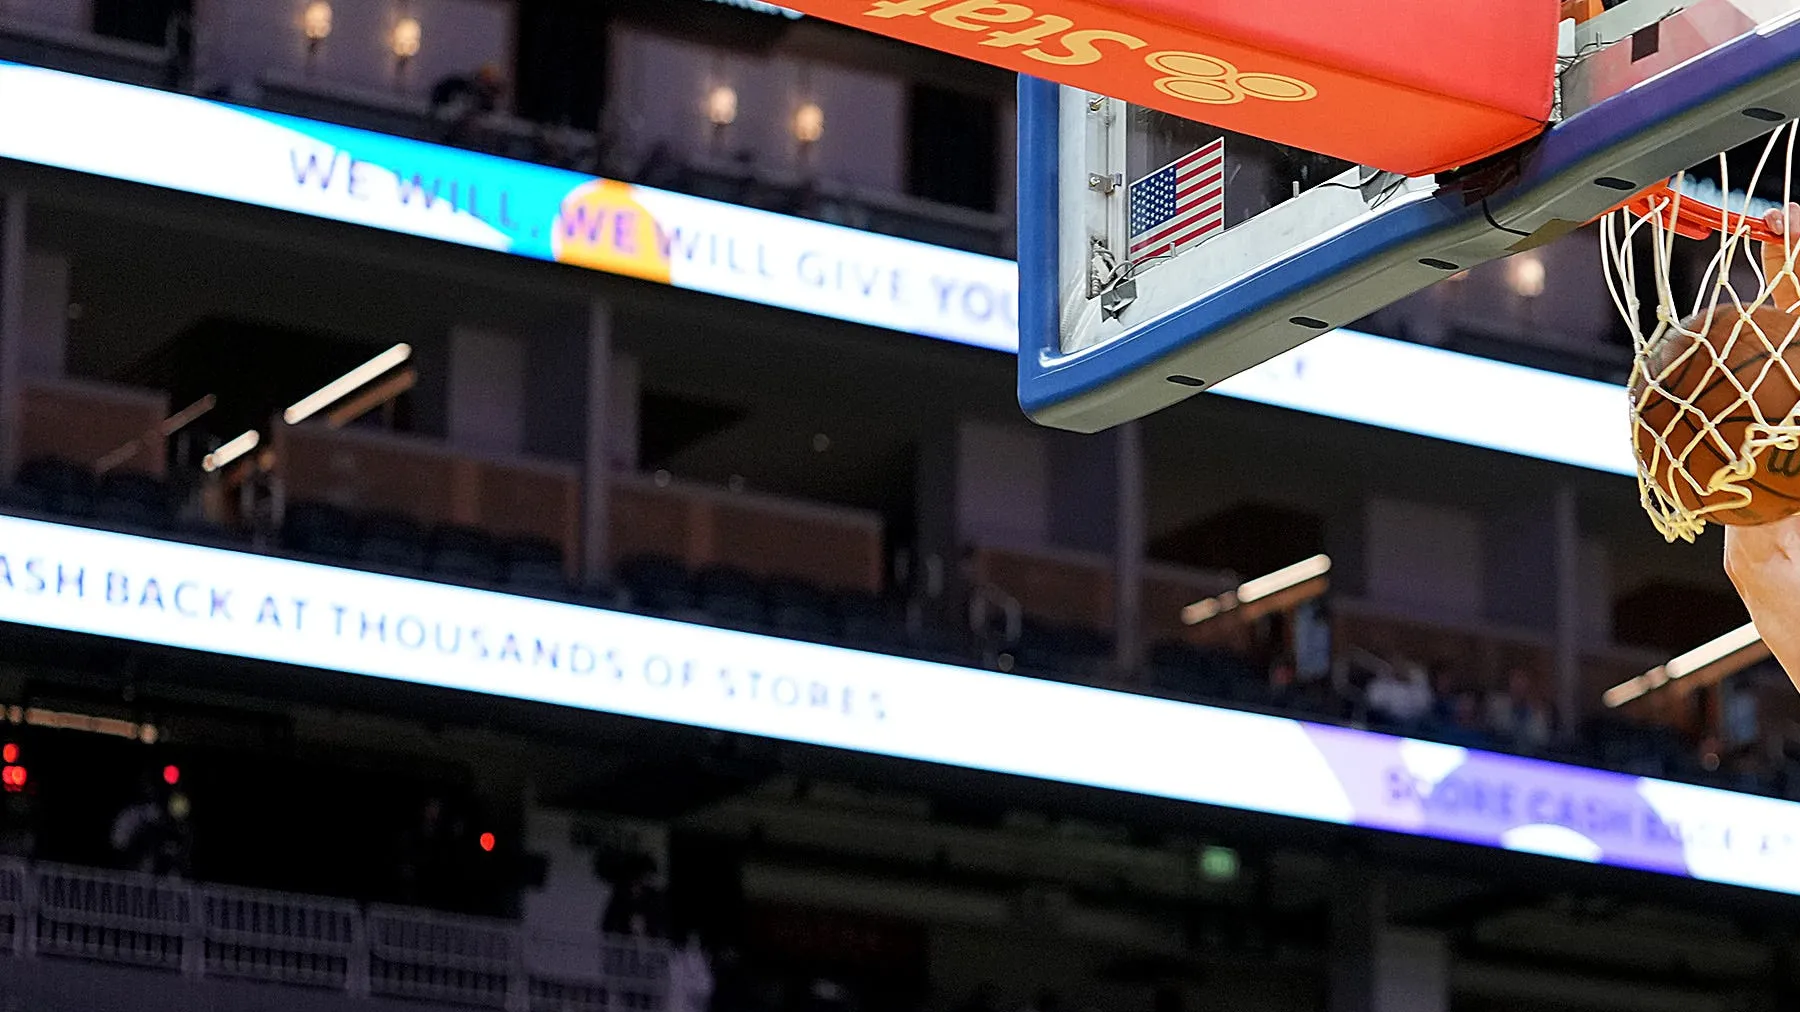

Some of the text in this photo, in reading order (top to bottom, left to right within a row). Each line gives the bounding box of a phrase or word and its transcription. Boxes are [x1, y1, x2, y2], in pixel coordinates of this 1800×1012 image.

[290, 148, 370, 200] WE
[561, 200, 638, 255] WE
[654, 217, 775, 279] WILL
[796, 250, 911, 307] GIVE
[105, 569, 233, 621] BACK
[256, 594, 312, 631] AT
[331, 604, 624, 682] THOUSANDS
[642, 654, 697, 690] OF
[718, 665, 888, 722] STORES
